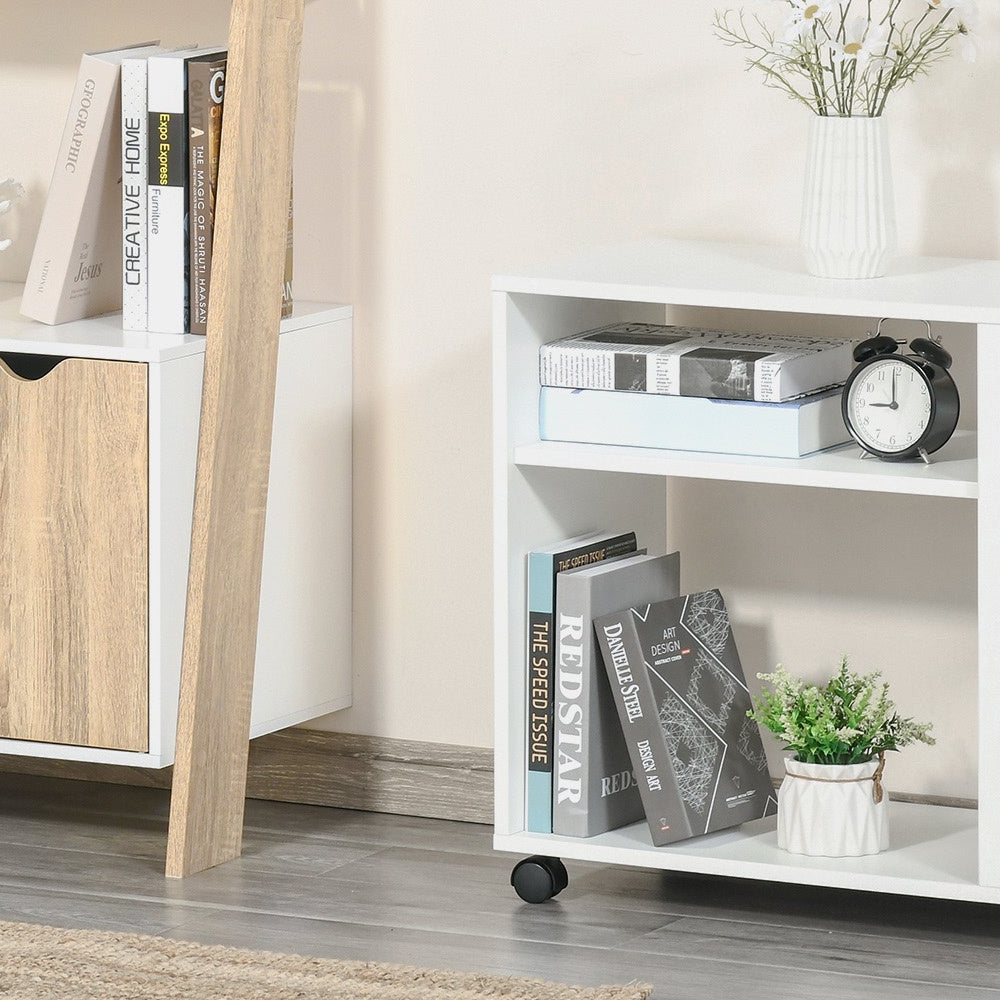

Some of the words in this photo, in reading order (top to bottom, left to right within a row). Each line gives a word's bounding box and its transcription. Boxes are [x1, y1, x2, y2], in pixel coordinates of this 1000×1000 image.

[65, 79, 95, 173] GEOGRAPHIC
[158, 113, 170, 140] Expo
[125, 118, 140, 174] HOME
[158, 143, 170, 186] Express
[151, 188, 161, 235] Furniture
[197, 215, 205, 231] OF
[125, 184, 140, 286] CREATIVE
[74, 262, 103, 282] Jesus
[878, 371, 885, 381] 11
[866, 382, 874, 393] 10
[920, 385, 926, 395] 2
[859, 398, 866, 408] 9
[875, 428, 881, 439] 7
[889, 435, 896, 445] 6
[906, 432, 912, 441] 5
[532, 621, 548, 654] THE
[663, 627, 676, 640] ART
[651, 640, 680, 656] DESIGN
[532, 657, 548, 709] SPEED
[558, 612, 583, 804] REDSTAR
[531, 713, 548, 764] ISSUE
[637, 740, 657, 772] DESIGN
[646, 775, 661, 792] ART
